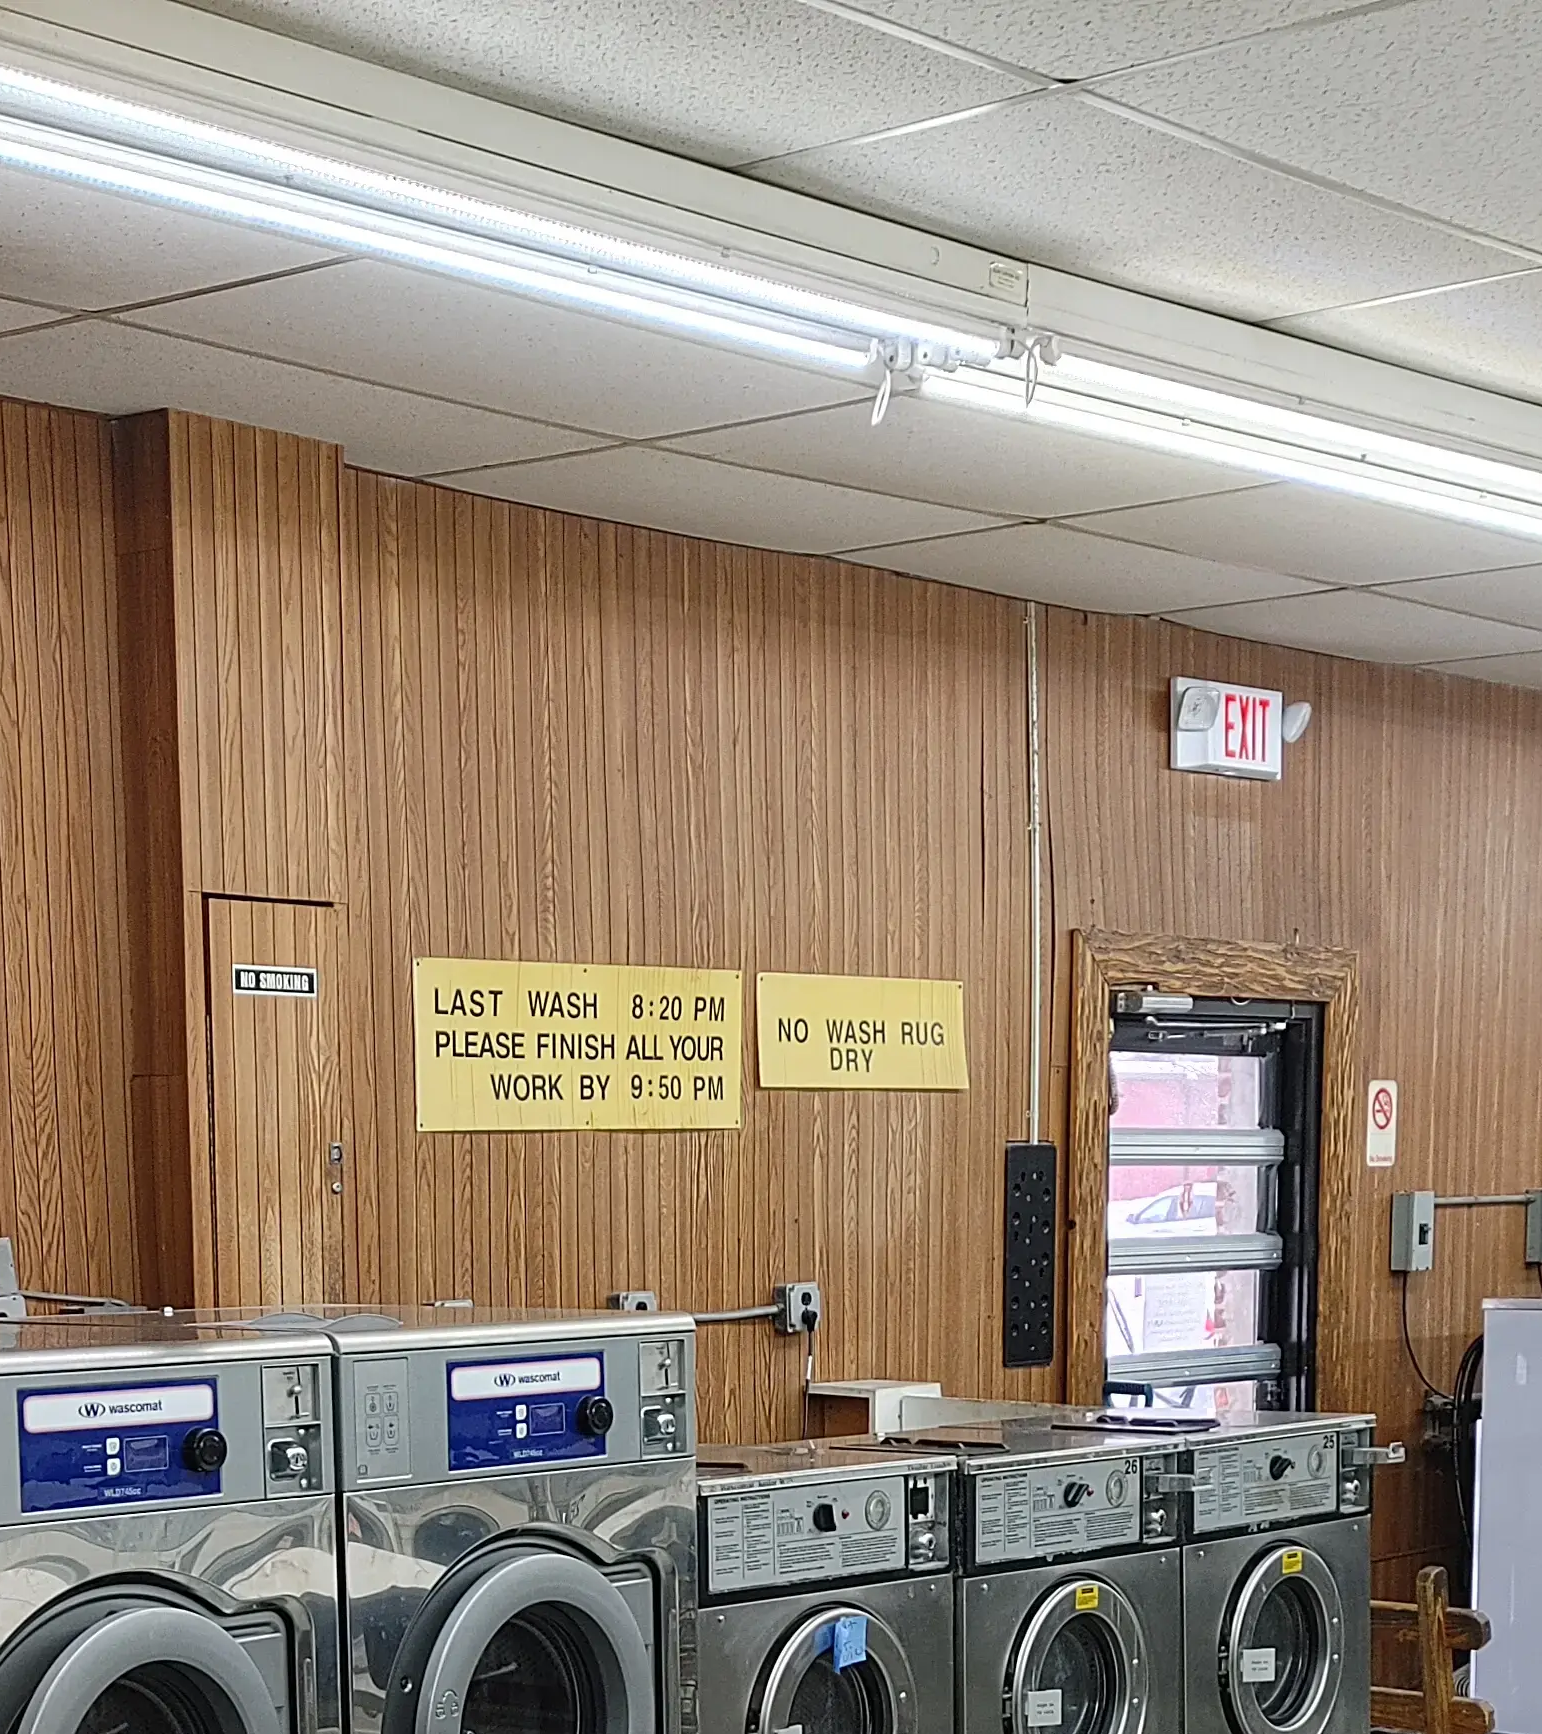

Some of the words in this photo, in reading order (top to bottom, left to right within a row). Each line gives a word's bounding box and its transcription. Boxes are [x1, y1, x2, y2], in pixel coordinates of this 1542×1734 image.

[1225, 694, 1270, 762] EXIT
[240, 971, 256, 988] NO
[259, 972, 309, 991] SMOKING
[434, 988, 503, 1017] LAST
[528, 990, 598, 1019] WASH
[632, 994, 683, 1021] 8:20
[694, 997, 725, 1022] PM
[778, 1017, 809, 1043] NO
[826, 1019, 886, 1044] WASH
[901, 1022, 945, 1046] RUG
[435, 1030, 526, 1059] PLEASE
[537, 1033, 615, 1060] FINISH
[626, 1035, 664, 1060] ALL
[669, 1035, 724, 1061] YOUR
[830, 1047, 873, 1073] DRY
[490, 1074, 564, 1100] WORK
[580, 1075, 611, 1100] BY
[630, 1074, 682, 1100] 9:50
[693, 1076, 724, 1101] PM
[518, 1371, 560, 1384] wascomat
[109, 1399, 163, 1414] wascomat
[1323, 1434, 1335, 1449] 25
[1124, 1459, 1138, 1475] 26
